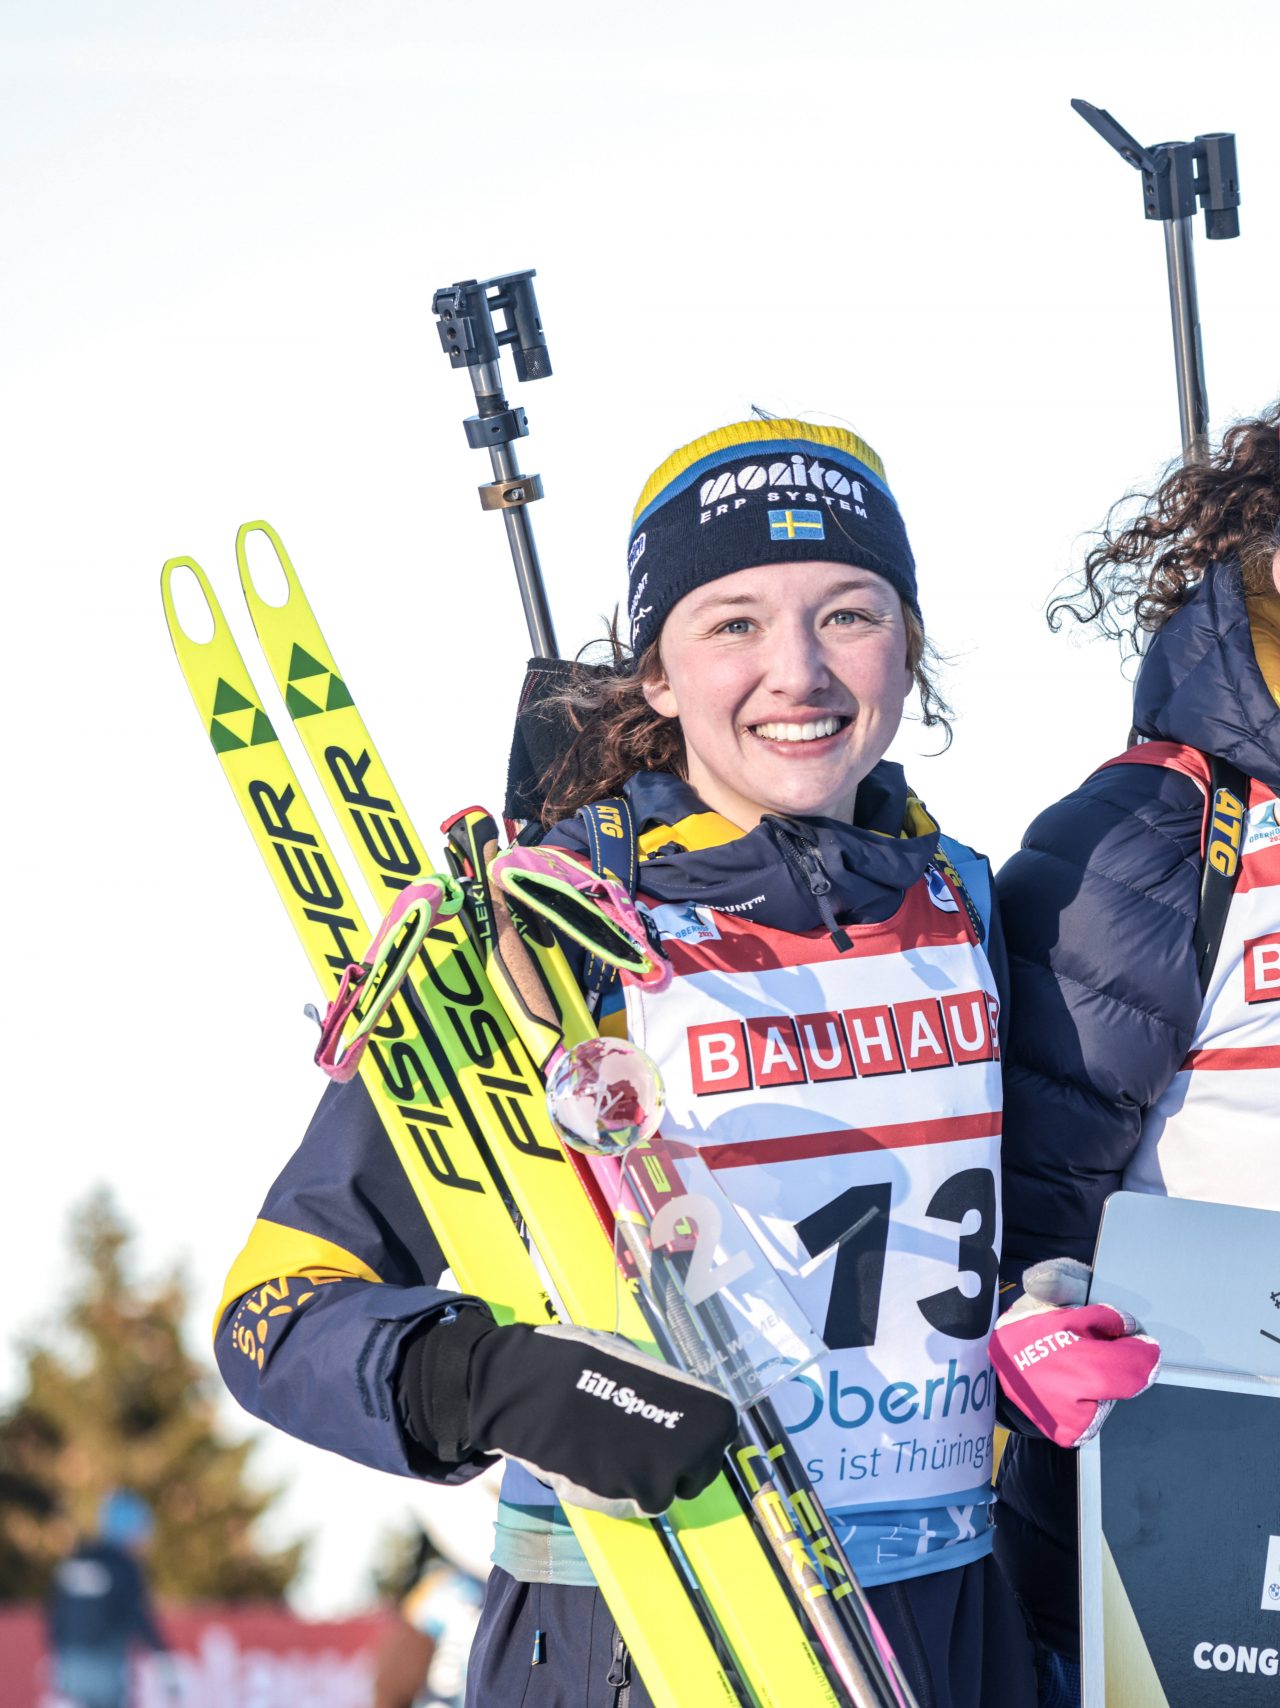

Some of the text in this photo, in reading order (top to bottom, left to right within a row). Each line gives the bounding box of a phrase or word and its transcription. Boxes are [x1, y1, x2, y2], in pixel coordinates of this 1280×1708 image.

[700, 455, 867, 507] monitor
[700, 491, 867, 524] ERP SYSTEM
[595, 804, 625, 839] ATG
[1212, 788, 1242, 877] ATG
[471, 881, 491, 938] LEKI
[650, 1193, 755, 1305] 2
[793, 1167, 999, 1350] 13
[838, 1446, 883, 1481] ist
